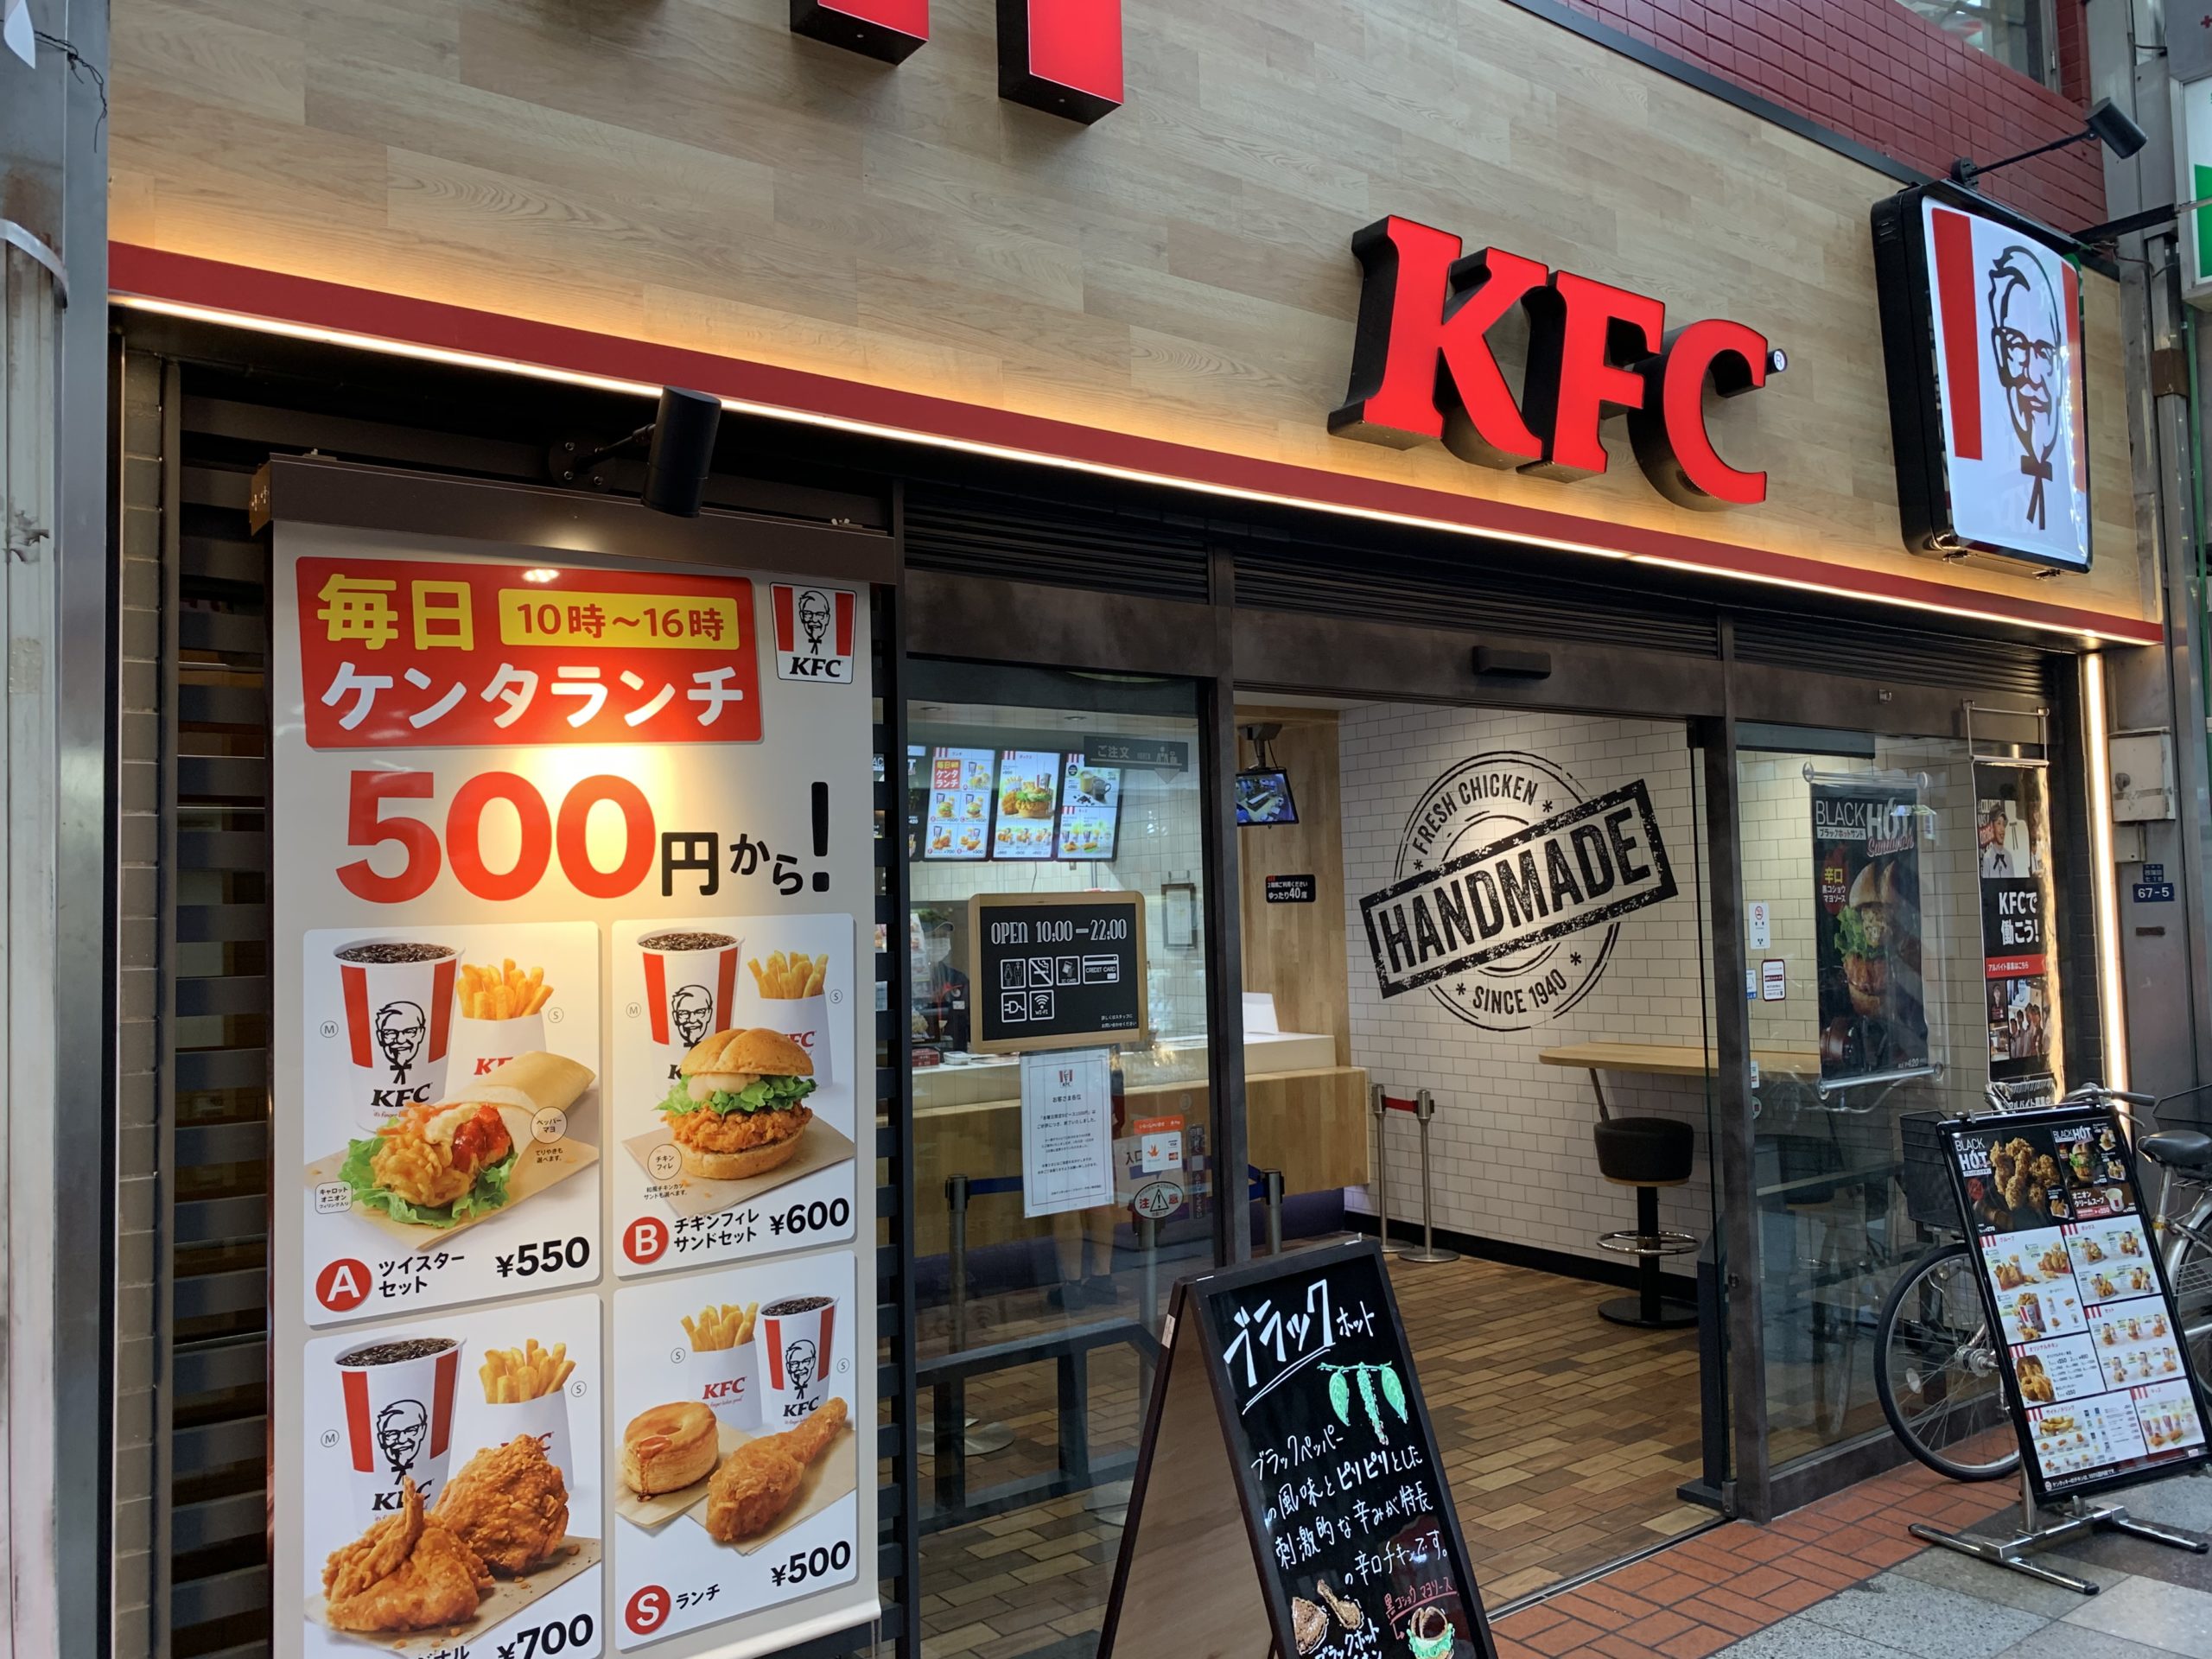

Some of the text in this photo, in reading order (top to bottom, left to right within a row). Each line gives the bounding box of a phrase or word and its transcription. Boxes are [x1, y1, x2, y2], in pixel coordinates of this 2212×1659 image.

[1358, 214, 1770, 506] KFC
[316, 574, 475, 652] 毎日
[788, 655, 842, 678] KFC
[321, 661, 744, 731] ケンタランチ
[1097, 744, 1130, 760] ご注文
[1412, 773, 1539, 855] FRESH CHICKEN
[1815, 800, 1866, 827] BLACK
[1819, 828, 1864, 839] ブラックホットサンド
[1866, 829, 1915, 858] Sandwich
[1824, 867, 1843, 884] 辛口
[1268, 887, 1307, 899] ゆったり40席
[1378, 806, 1651, 975] HANDMADE
[1821, 885, 1847, 894] 黒コショウ
[1823, 894, 1847, 904] マヨソース
[2138, 887, 2170, 899] 67-5
[1999, 891, 2038, 915] KFCで
[991, 921, 1029, 944] OPEN
[1472, 968, 1567, 1015] SINCE 1940
[785, 1030, 817, 1048] FC
[371, 1082, 431, 1109] KFC
[536, 1116, 563, 1127] ペッパー
[2052, 1128, 2075, 1139] BLACK
[2074, 1125, 2092, 1141] HOT
[535, 1148, 563, 1157] てりやきも
[1955, 1138, 1986, 1152] BLACK
[655, 1154, 675, 1163] チキン
[656, 1162, 674, 1171] フィレ
[319, 1186, 349, 1195] キャロット
[321, 1194, 347, 1203] オニオン
[2072, 1192, 2092, 1200] オニオン
[2075, 1198, 2105, 1208] クリームスープ
[674, 1208, 760, 1235] チキンフィレ
[769, 1198, 850, 1236] ¥600
[634, 1224, 659, 1257] B
[673, 1226, 758, 1253] サンドセット
[378, 1252, 465, 1277] ツイスター
[495, 1235, 591, 1279] ¥550
[327, 1265, 361, 1303] A
[378, 1274, 429, 1298] セット
[1223, 1279, 1376, 1388] ブラック ホット
[702, 1376, 747, 1401] KFC
[783, 1395, 820, 1418] KFC
[1251, 1425, 1344, 1481] ブラックペッパー
[1267, 1445, 1424, 1525] の風味とピリピリとした
[1275, 1481, 1433, 1570] 刺激的な辛みが特長
[771, 1541, 851, 1587] ¥500
[636, 1592, 660, 1627] S
[675, 1583, 721, 1611] ランチ
[496, 1613, 594, 1658] ¥700
